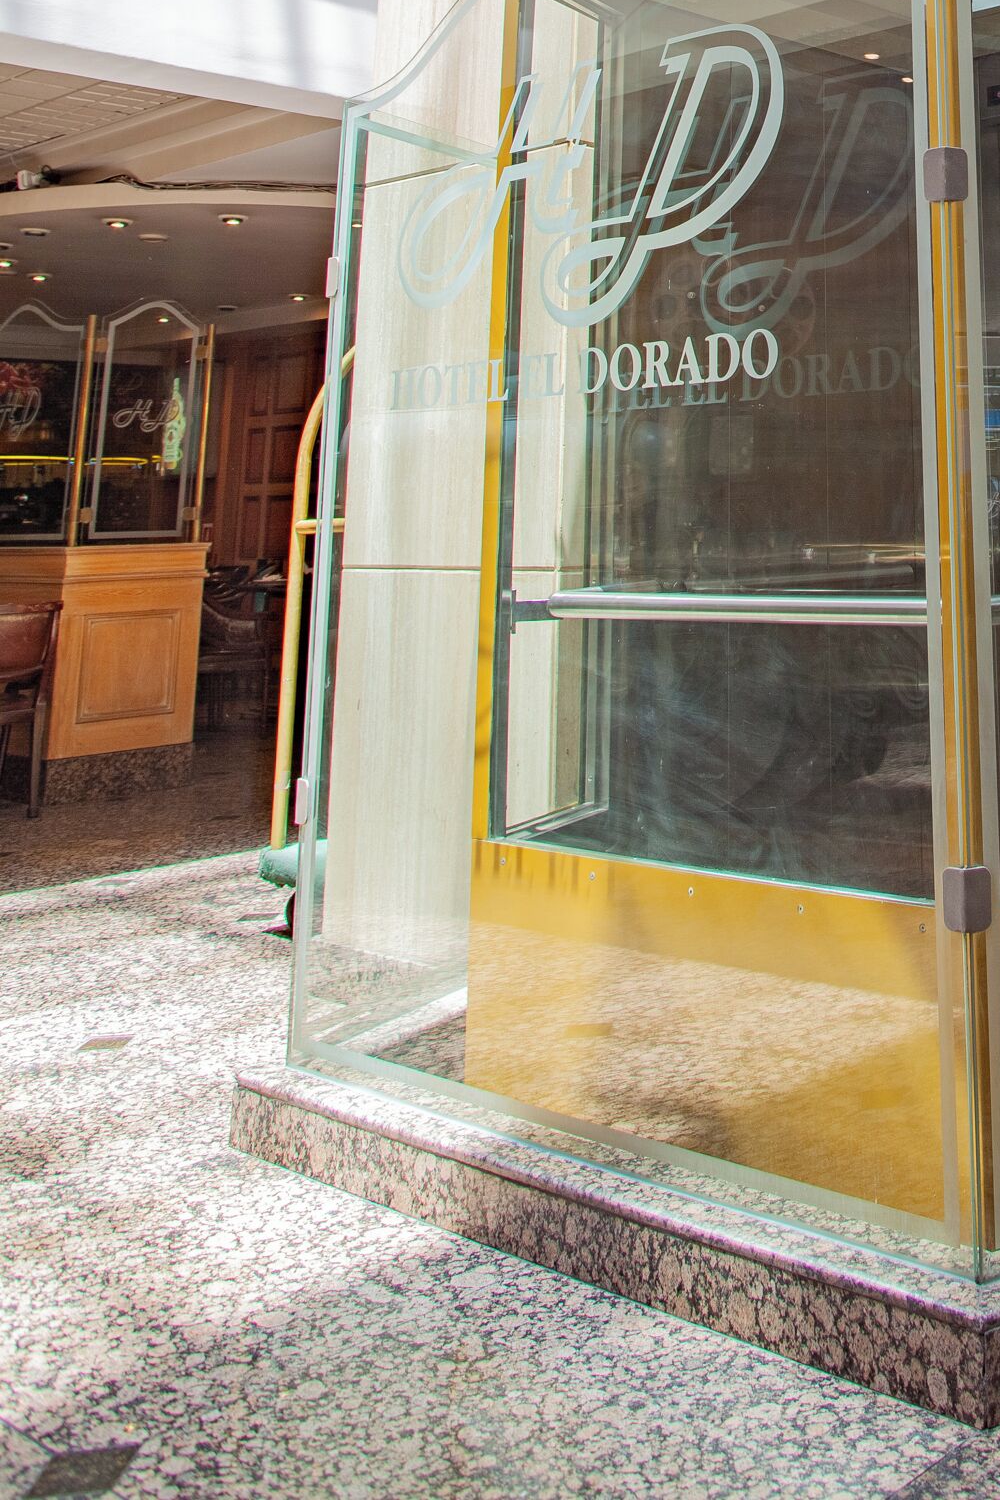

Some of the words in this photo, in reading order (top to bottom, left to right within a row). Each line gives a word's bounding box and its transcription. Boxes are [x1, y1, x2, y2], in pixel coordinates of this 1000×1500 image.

[391, 358, 509, 411] HOTEL
[521, 352, 565, 399] EL
[578, 329, 780, 395] DORADO
